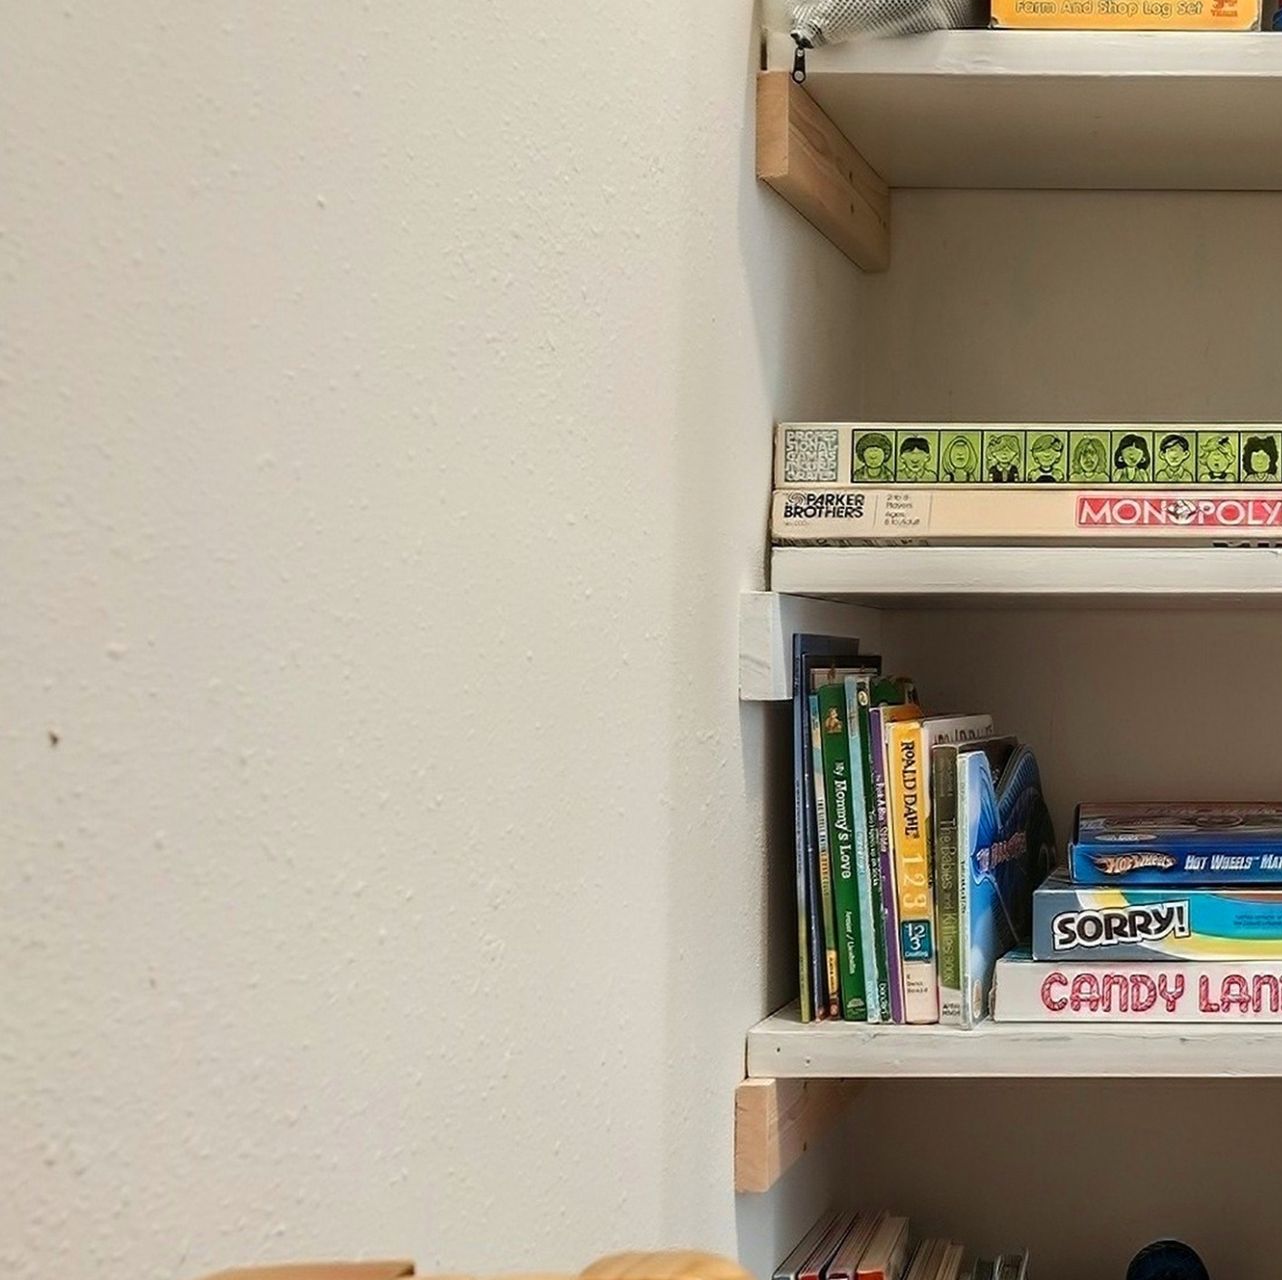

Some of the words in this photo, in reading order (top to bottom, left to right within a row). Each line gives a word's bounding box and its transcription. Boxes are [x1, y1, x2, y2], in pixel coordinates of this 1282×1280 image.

[1015, 0, 1056, 15] Farm
[1061, 0, 1093, 15] And
[1098, 0, 1139, 18] Shop
[1143, 0, 1173, 18] Log
[1177, 0, 1204, 15] Set
[784, 506, 864, 518] BROTHERS
[806, 493, 865, 506] PARKER
[1080, 499, 1282, 525] MONOPOLY
[833, 761, 844, 776] My
[901, 741, 918, 791] ROALD
[834, 780, 852, 841] Mommy's
[903, 794, 919, 836] DAHL
[940, 818, 957, 843] The
[839, 844, 852, 879] Love
[902, 853, 925, 865] 1
[940, 846, 957, 890] Babies
[1184, 855, 1207, 870] HOT
[1210, 855, 1253, 870] WHEELS
[903, 873, 926, 887] 2
[903, 892, 927, 909] 3
[943, 912, 958, 954] Kitties
[1055, 904, 1187, 945] SORRY!
[1041, 972, 1186, 1013] CANDY
